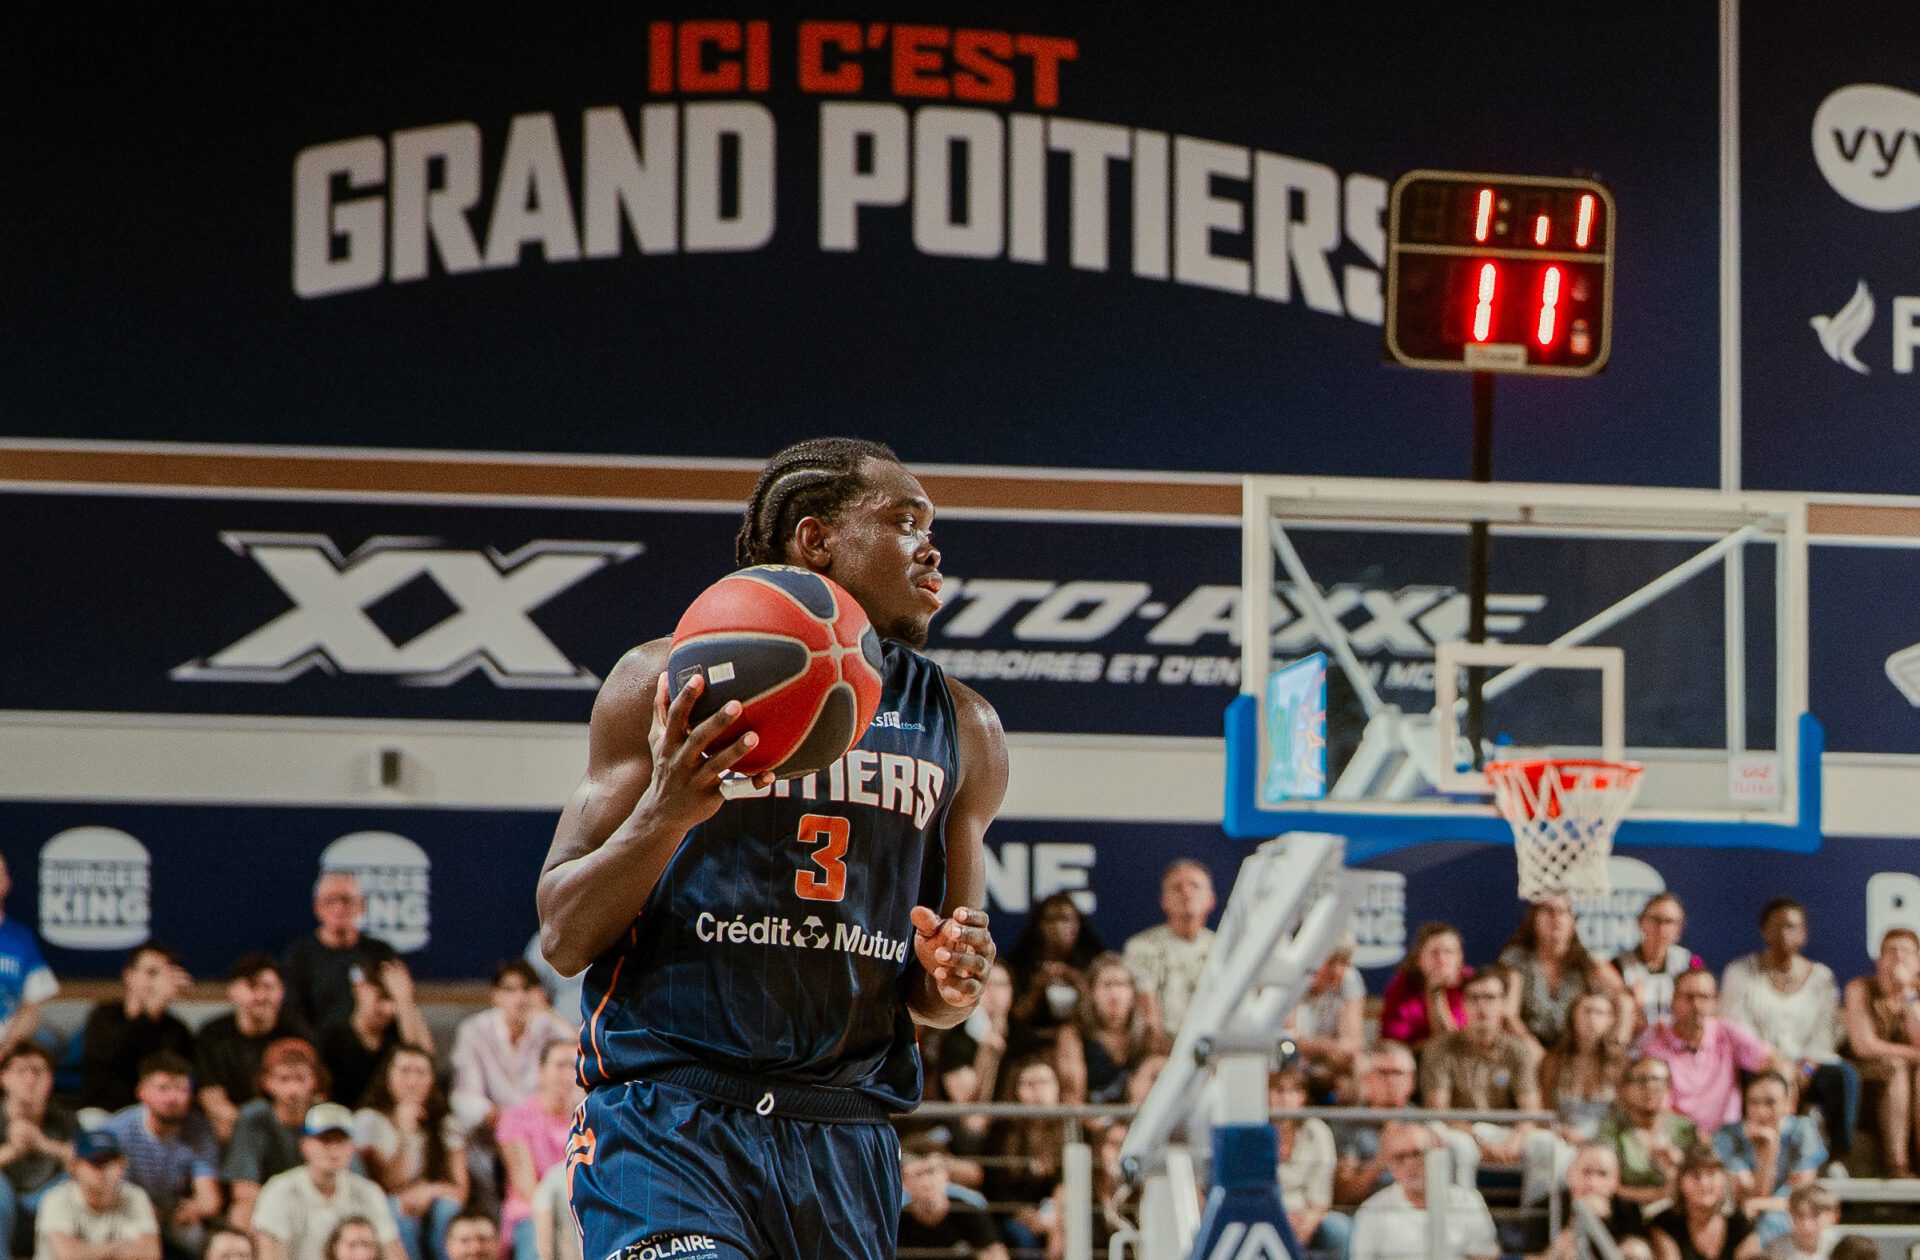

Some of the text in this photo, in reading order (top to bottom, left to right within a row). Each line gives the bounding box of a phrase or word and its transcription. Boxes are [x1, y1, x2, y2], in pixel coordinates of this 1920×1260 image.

[649, 20, 1079, 108] ICI C'EST
[291, 99, 1390, 327] GRAND POITIERS
[795, 813, 851, 902] 3
[983, 842, 1096, 916] NE
[696, 911, 791, 946] Crédit
